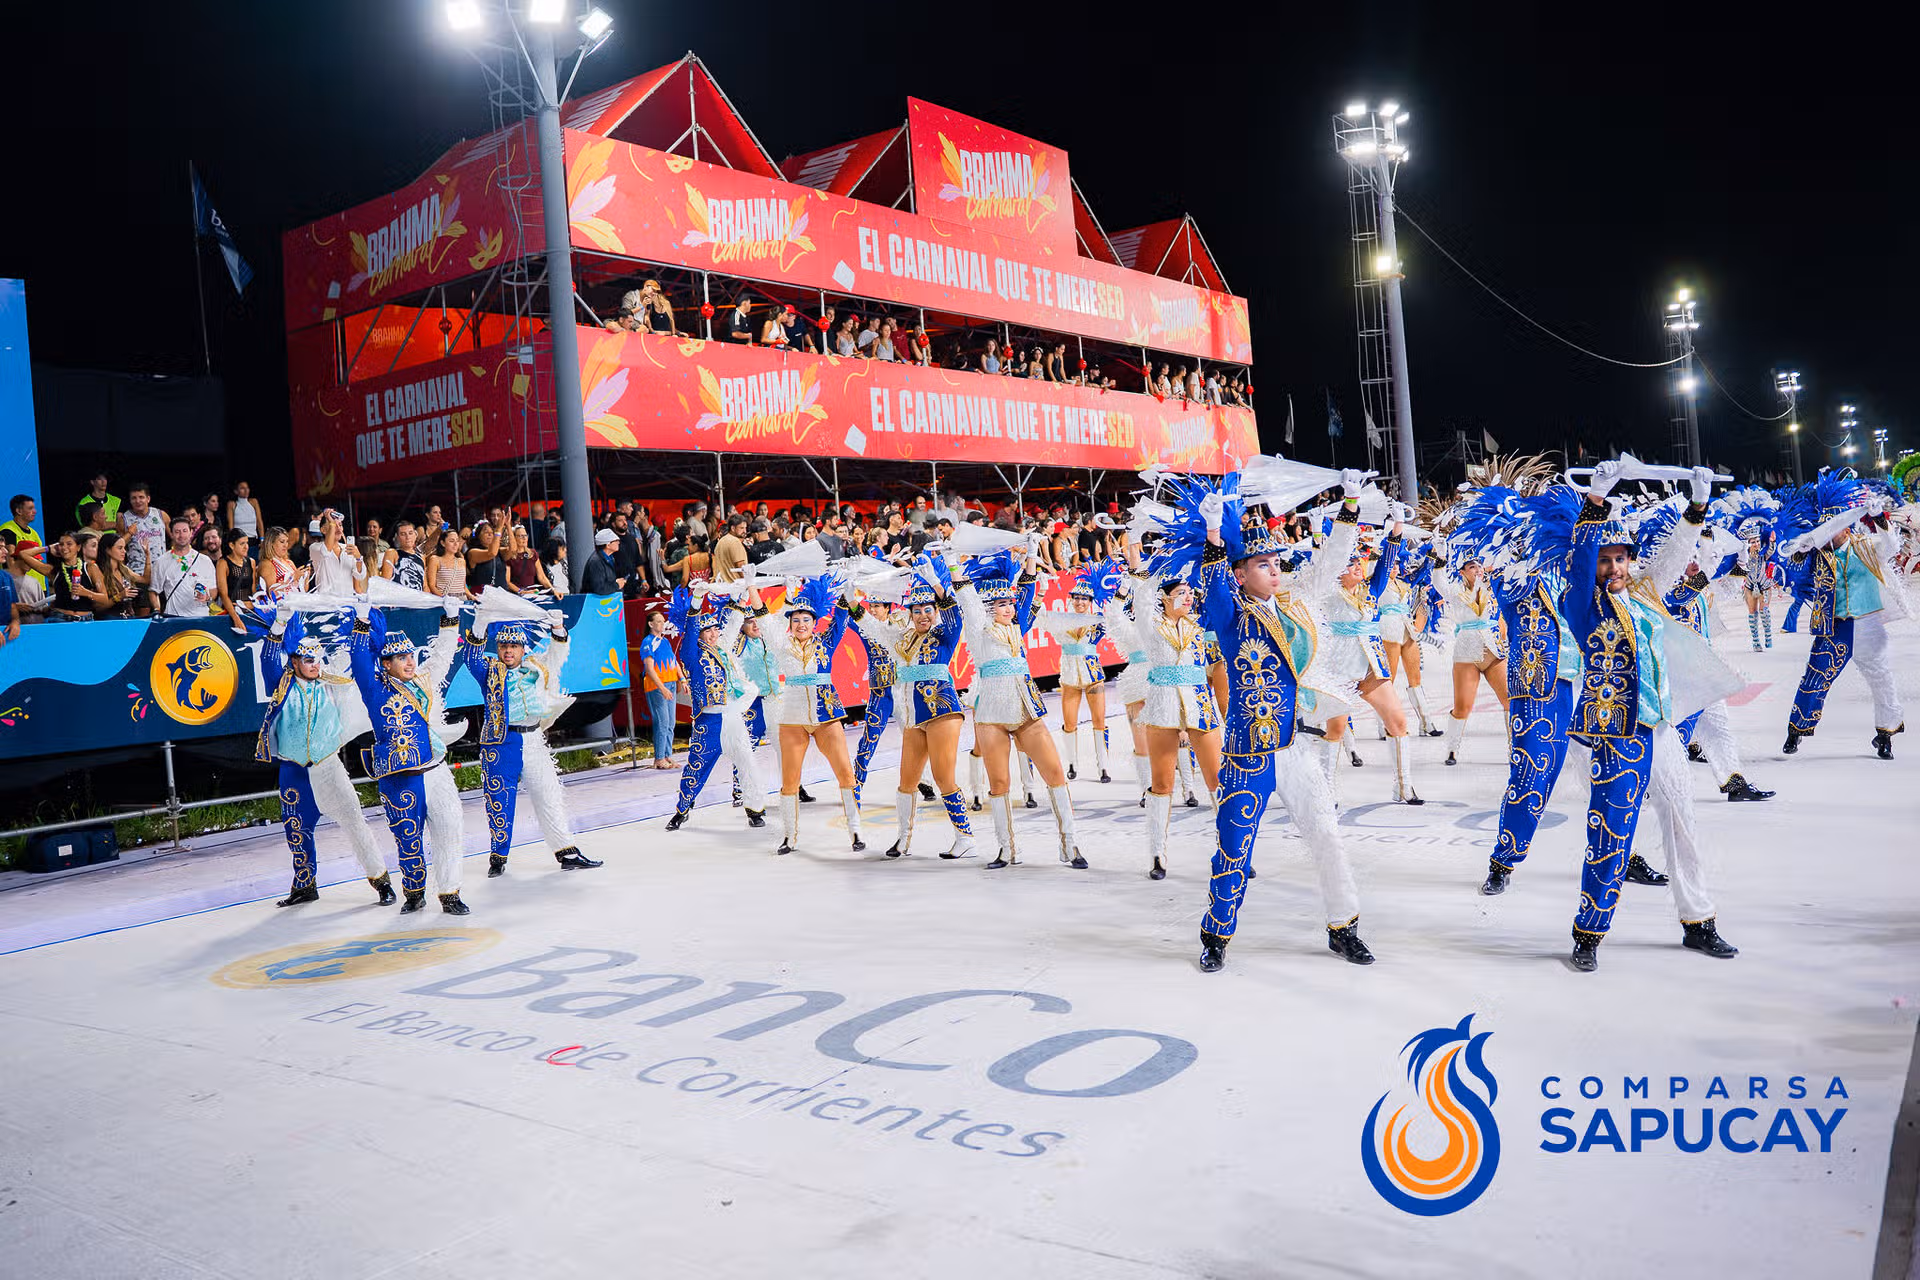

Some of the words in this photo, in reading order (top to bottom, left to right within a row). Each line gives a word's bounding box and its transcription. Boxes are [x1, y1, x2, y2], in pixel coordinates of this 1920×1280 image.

[960, 149, 1036, 200] BRAHMA
[367, 193, 441, 277] BRAHMA
[707, 198, 792, 244] BRAHMA
[858, 226, 884, 273] EL
[888, 233, 992, 294] CARNAVAL
[994, 257, 1030, 302] QUE
[1032, 266, 1053, 307] TE
[365, 393, 382, 427] EL
[384, 371, 468, 422] CARNAVAL
[720, 370, 804, 423] BRAHMA
[870, 387, 895, 432] EL
[899, 389, 1002, 438] CARNAVAL
[1005, 400, 1039, 443] QUE
[1041, 403, 1062, 443] TE
[356, 430, 385, 469] QUE
[387, 425, 406, 461] TE
[401, 945, 1198, 1097] BanCo
[301, 1001, 388, 1023] El
[356, 1010, 538, 1051] Banco
[534, 1041, 630, 1071] de
[637, 1056, 1065, 1157] Corrientes
